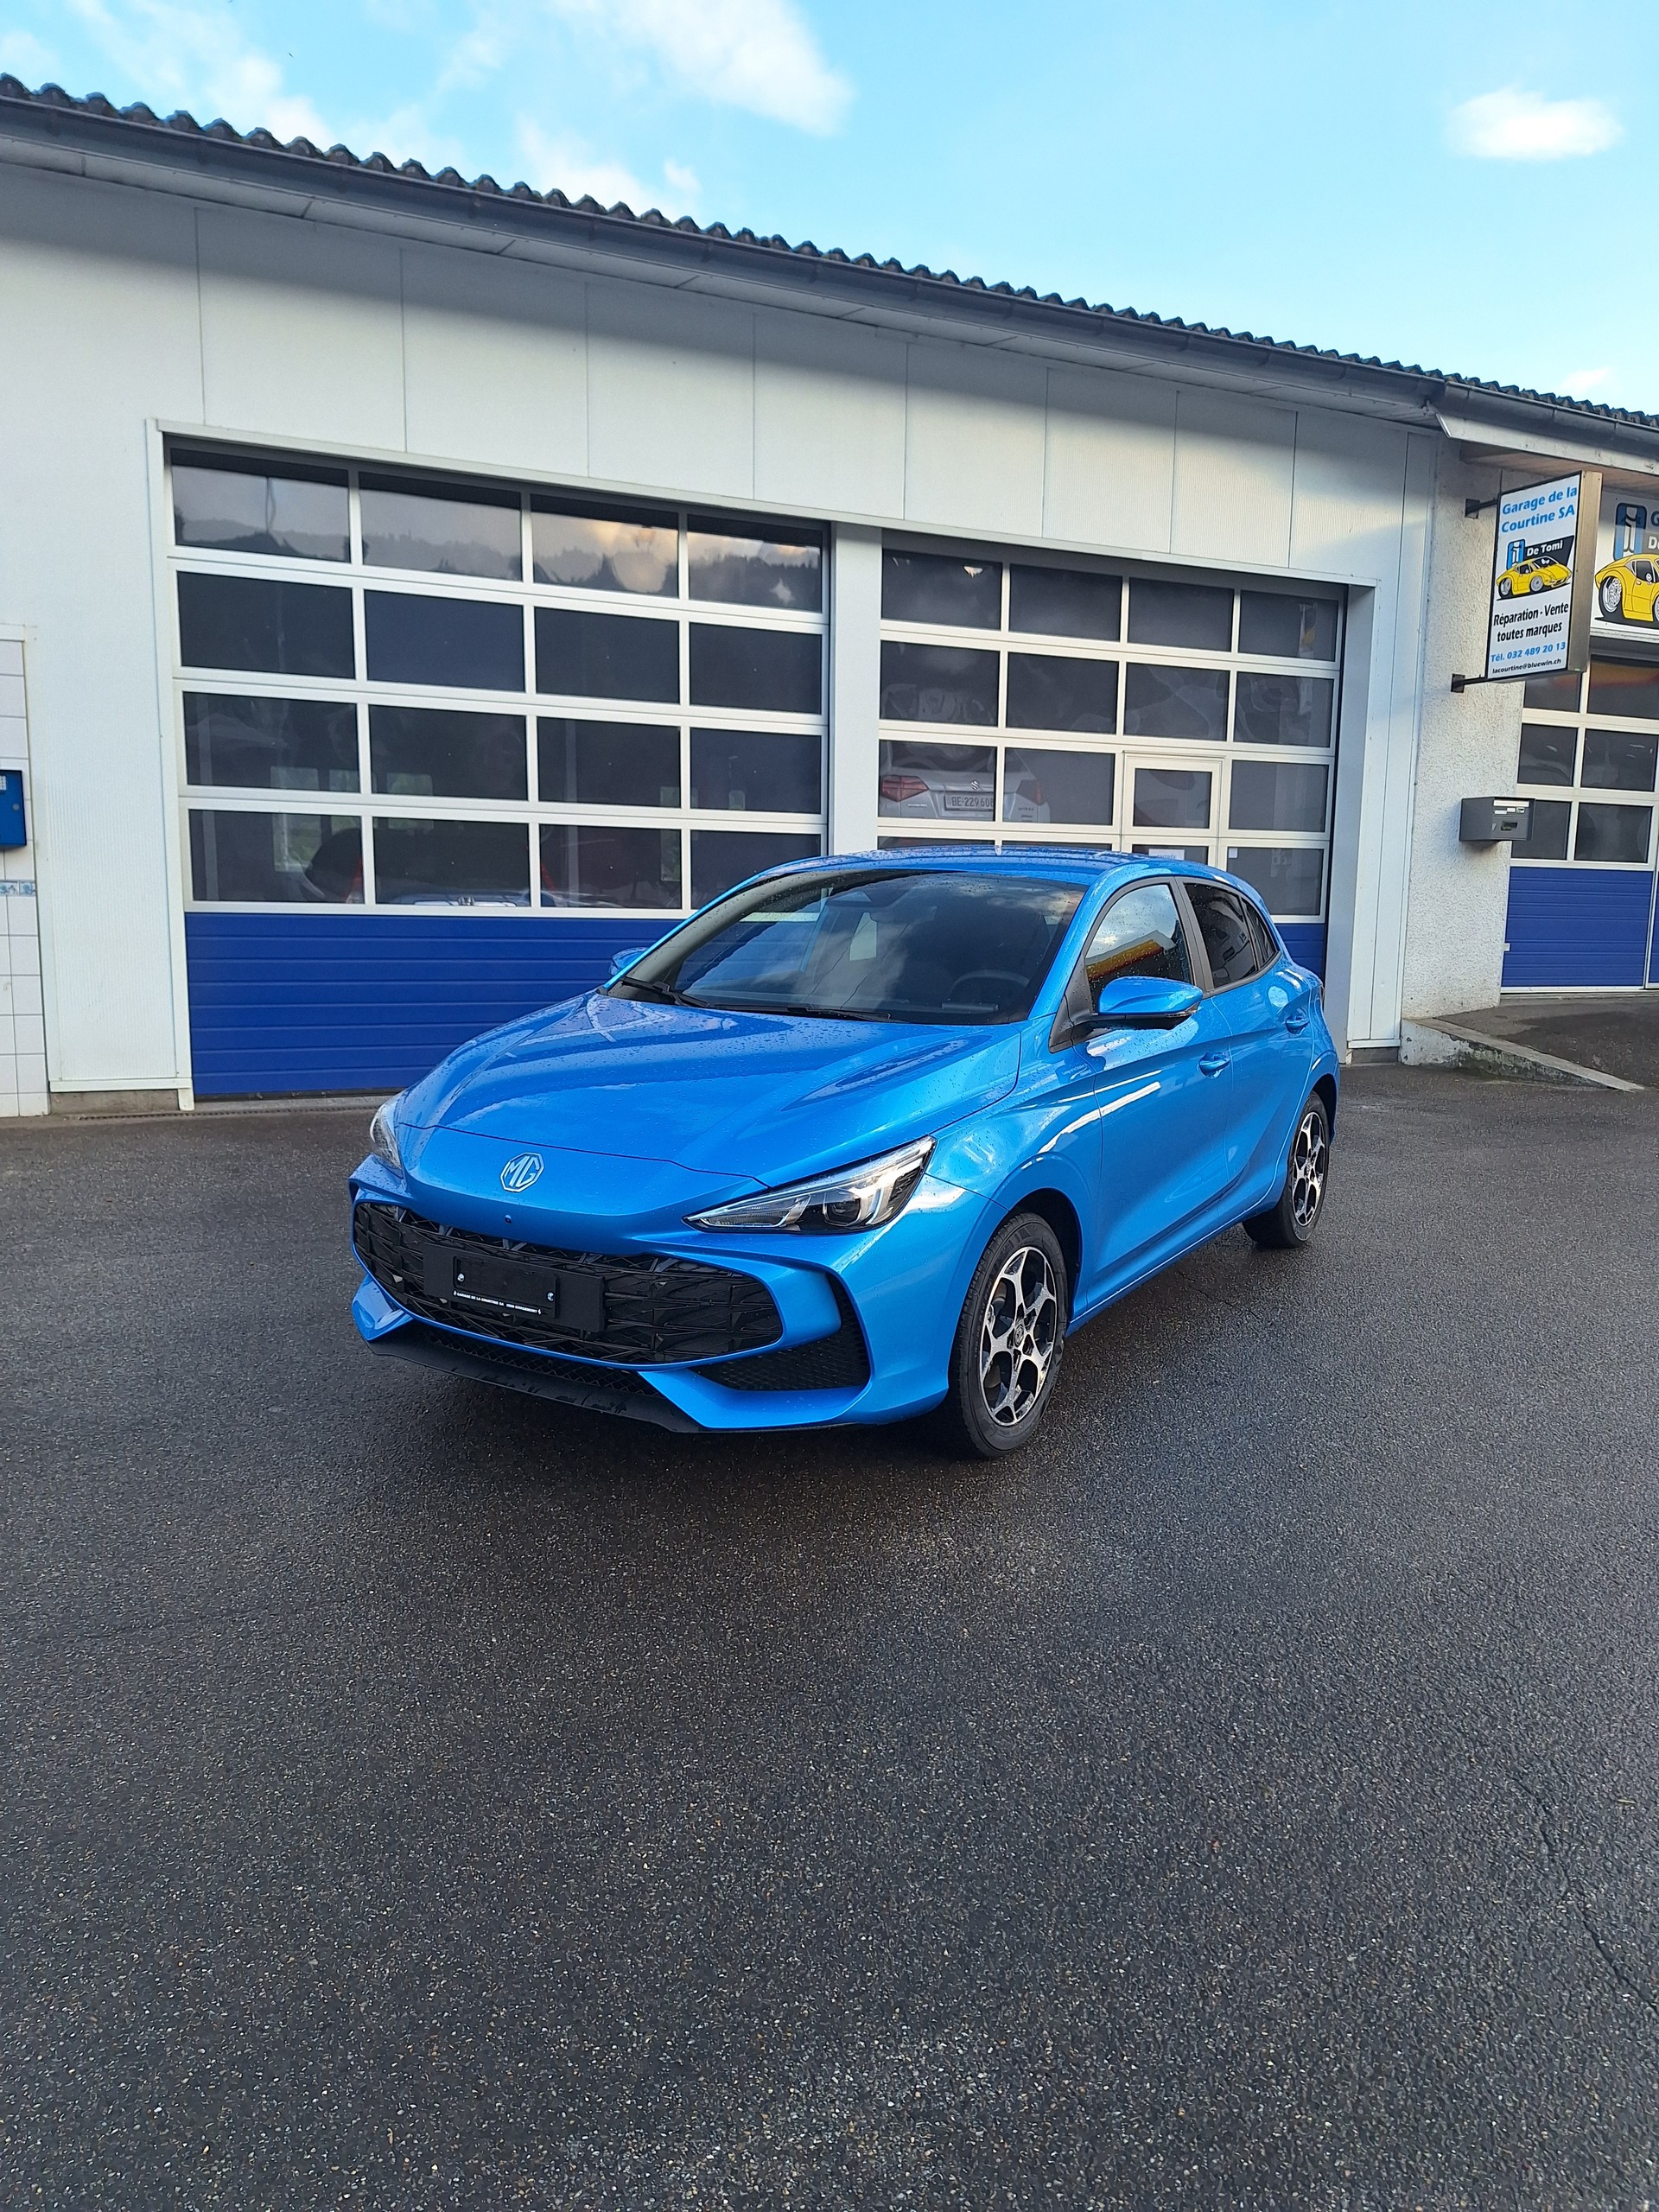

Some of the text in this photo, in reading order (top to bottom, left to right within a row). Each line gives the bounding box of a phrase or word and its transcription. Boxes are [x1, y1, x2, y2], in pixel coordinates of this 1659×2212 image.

[1503, 486, 1578, 515] Garage de la
[1502, 505, 1575, 532] Courtine SA
[1527, 540, 1563, 556] De Tomi
[1493, 608, 1539, 628] Réparation
[1545, 602, 1569, 617] Vente
[1497, 622, 1562, 642] toutes marques
[1491, 641, 1566, 663] Tél. 032 489 20 13
[1492, 658, 1561, 674] lacourtine@bluewin.ch
[504, 1155, 540, 1187] MG
